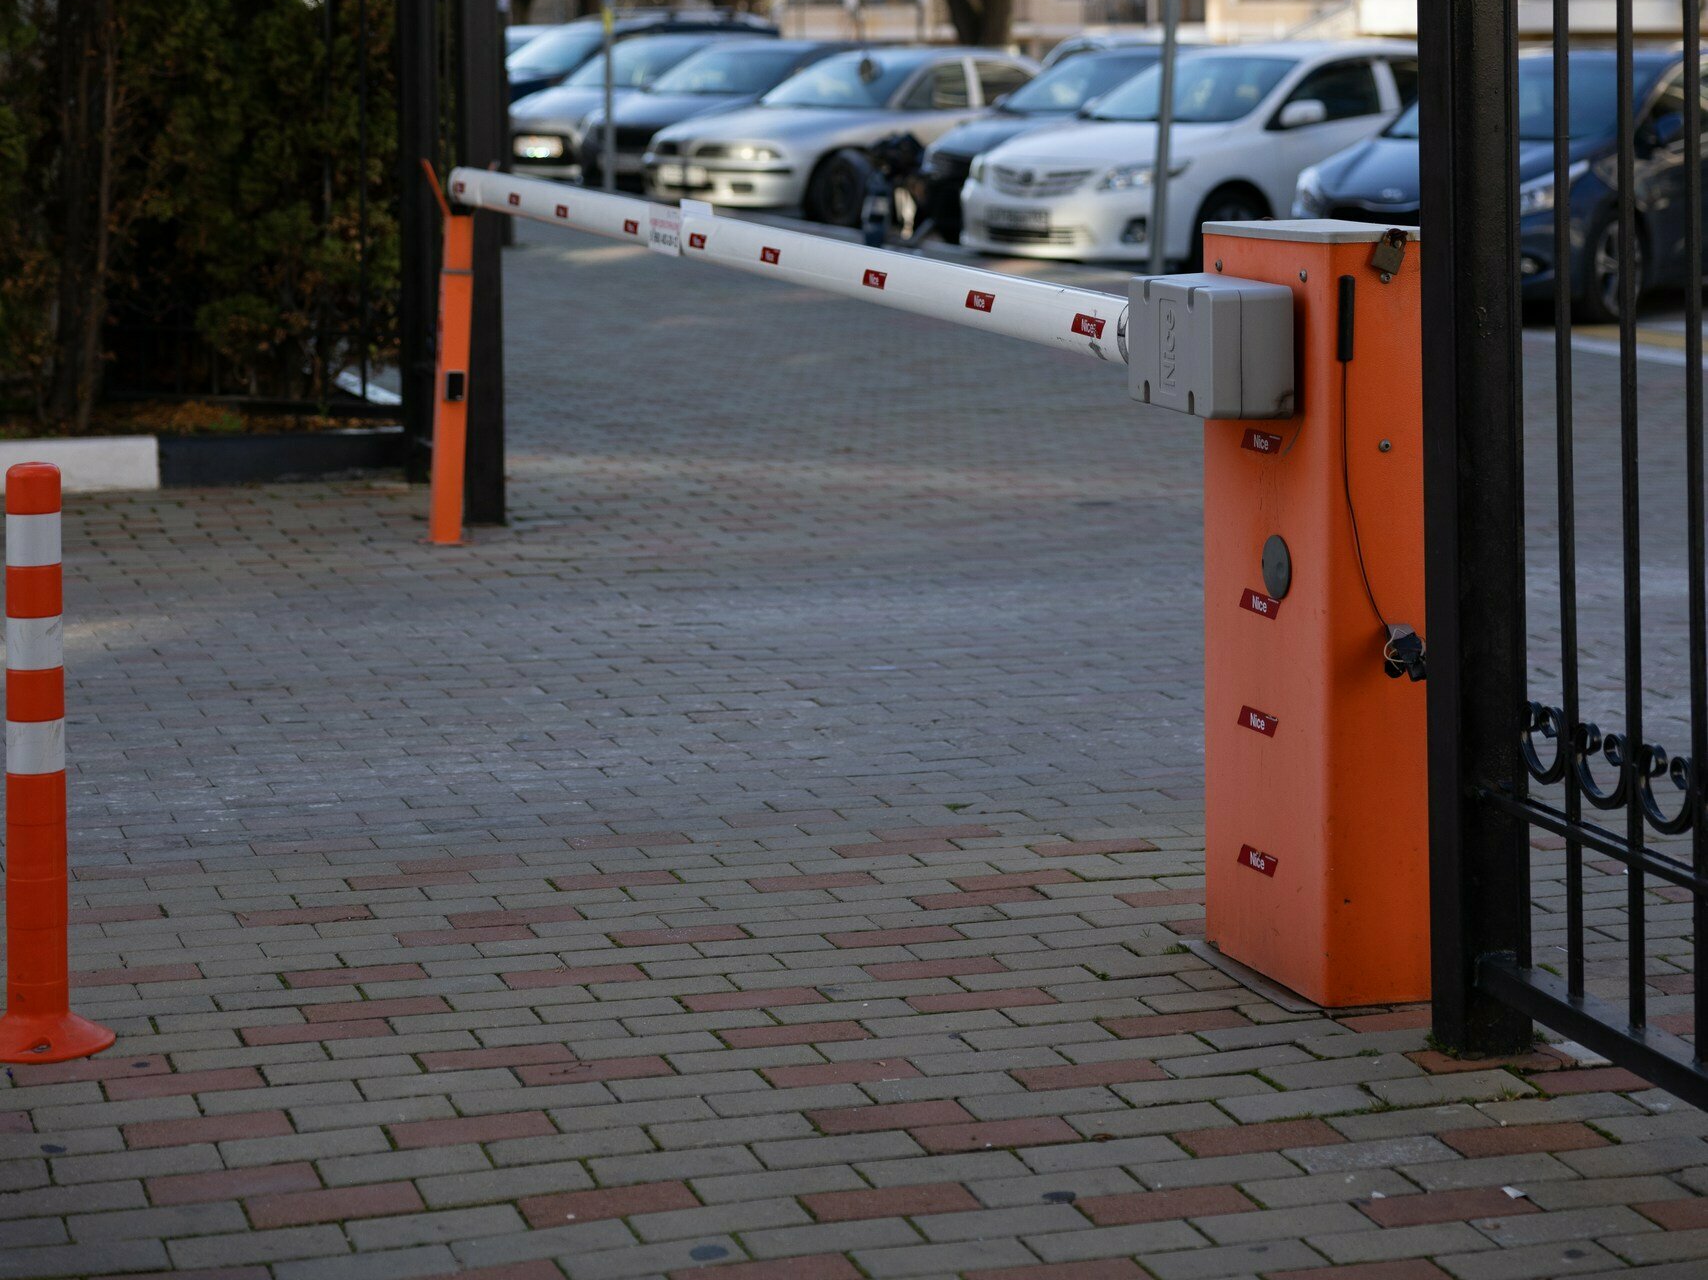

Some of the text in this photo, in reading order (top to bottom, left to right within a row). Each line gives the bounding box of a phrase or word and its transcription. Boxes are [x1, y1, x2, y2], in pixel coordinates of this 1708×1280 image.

[973, 294, 985, 309] Nice
[1080, 318, 1095, 334] Nice
[1161, 308, 1176, 389] Nice
[1253, 434, 1269, 450] Nice
[1251, 595, 1267, 613] Nice
[1250, 712, 1265, 730] Nice
[1249, 850, 1265, 870] Nice
